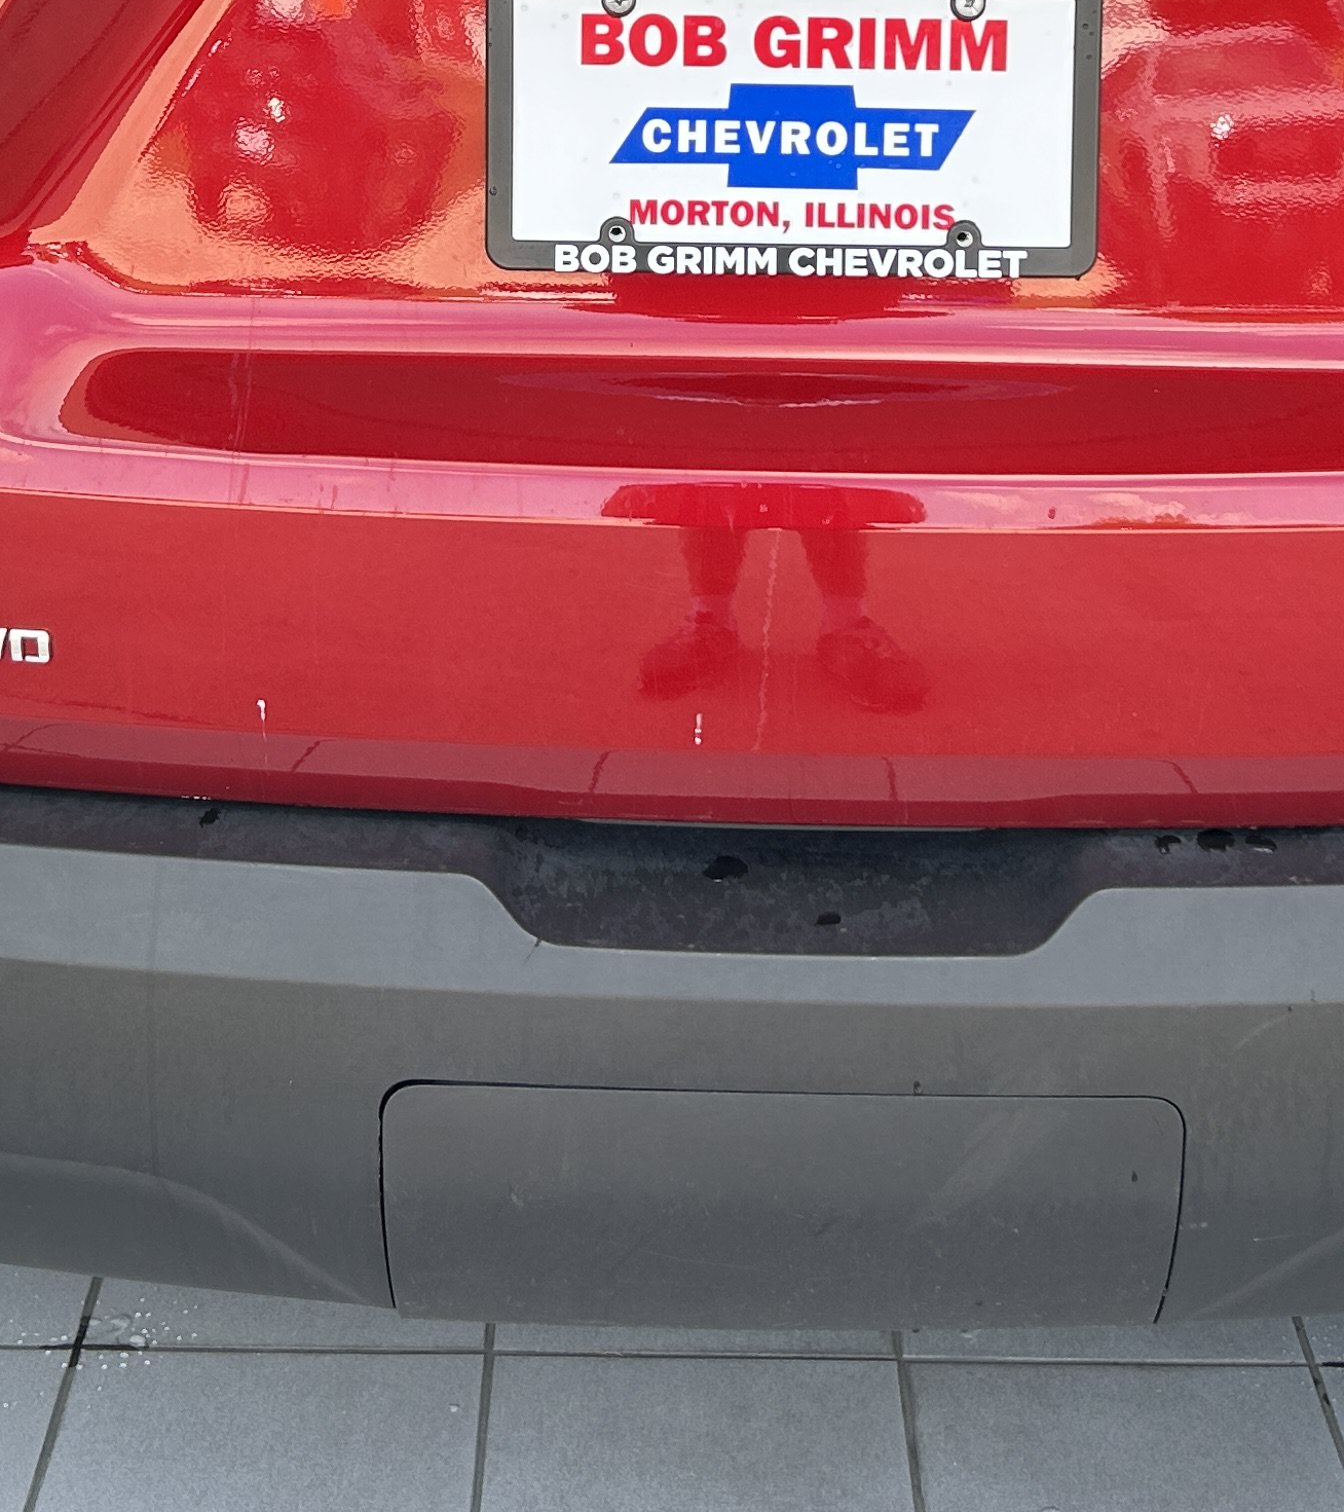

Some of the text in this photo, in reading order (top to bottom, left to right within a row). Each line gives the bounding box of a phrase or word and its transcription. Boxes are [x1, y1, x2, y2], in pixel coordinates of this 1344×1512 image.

[580, 13, 1009, 73] BOB GRIMM
[641, 118, 940, 158] CHEVROLET
[630, 199, 956, 234] MORTON, ILLINOIS
[554, 243, 1028, 280] BOB GRIMM CHEVROLET
